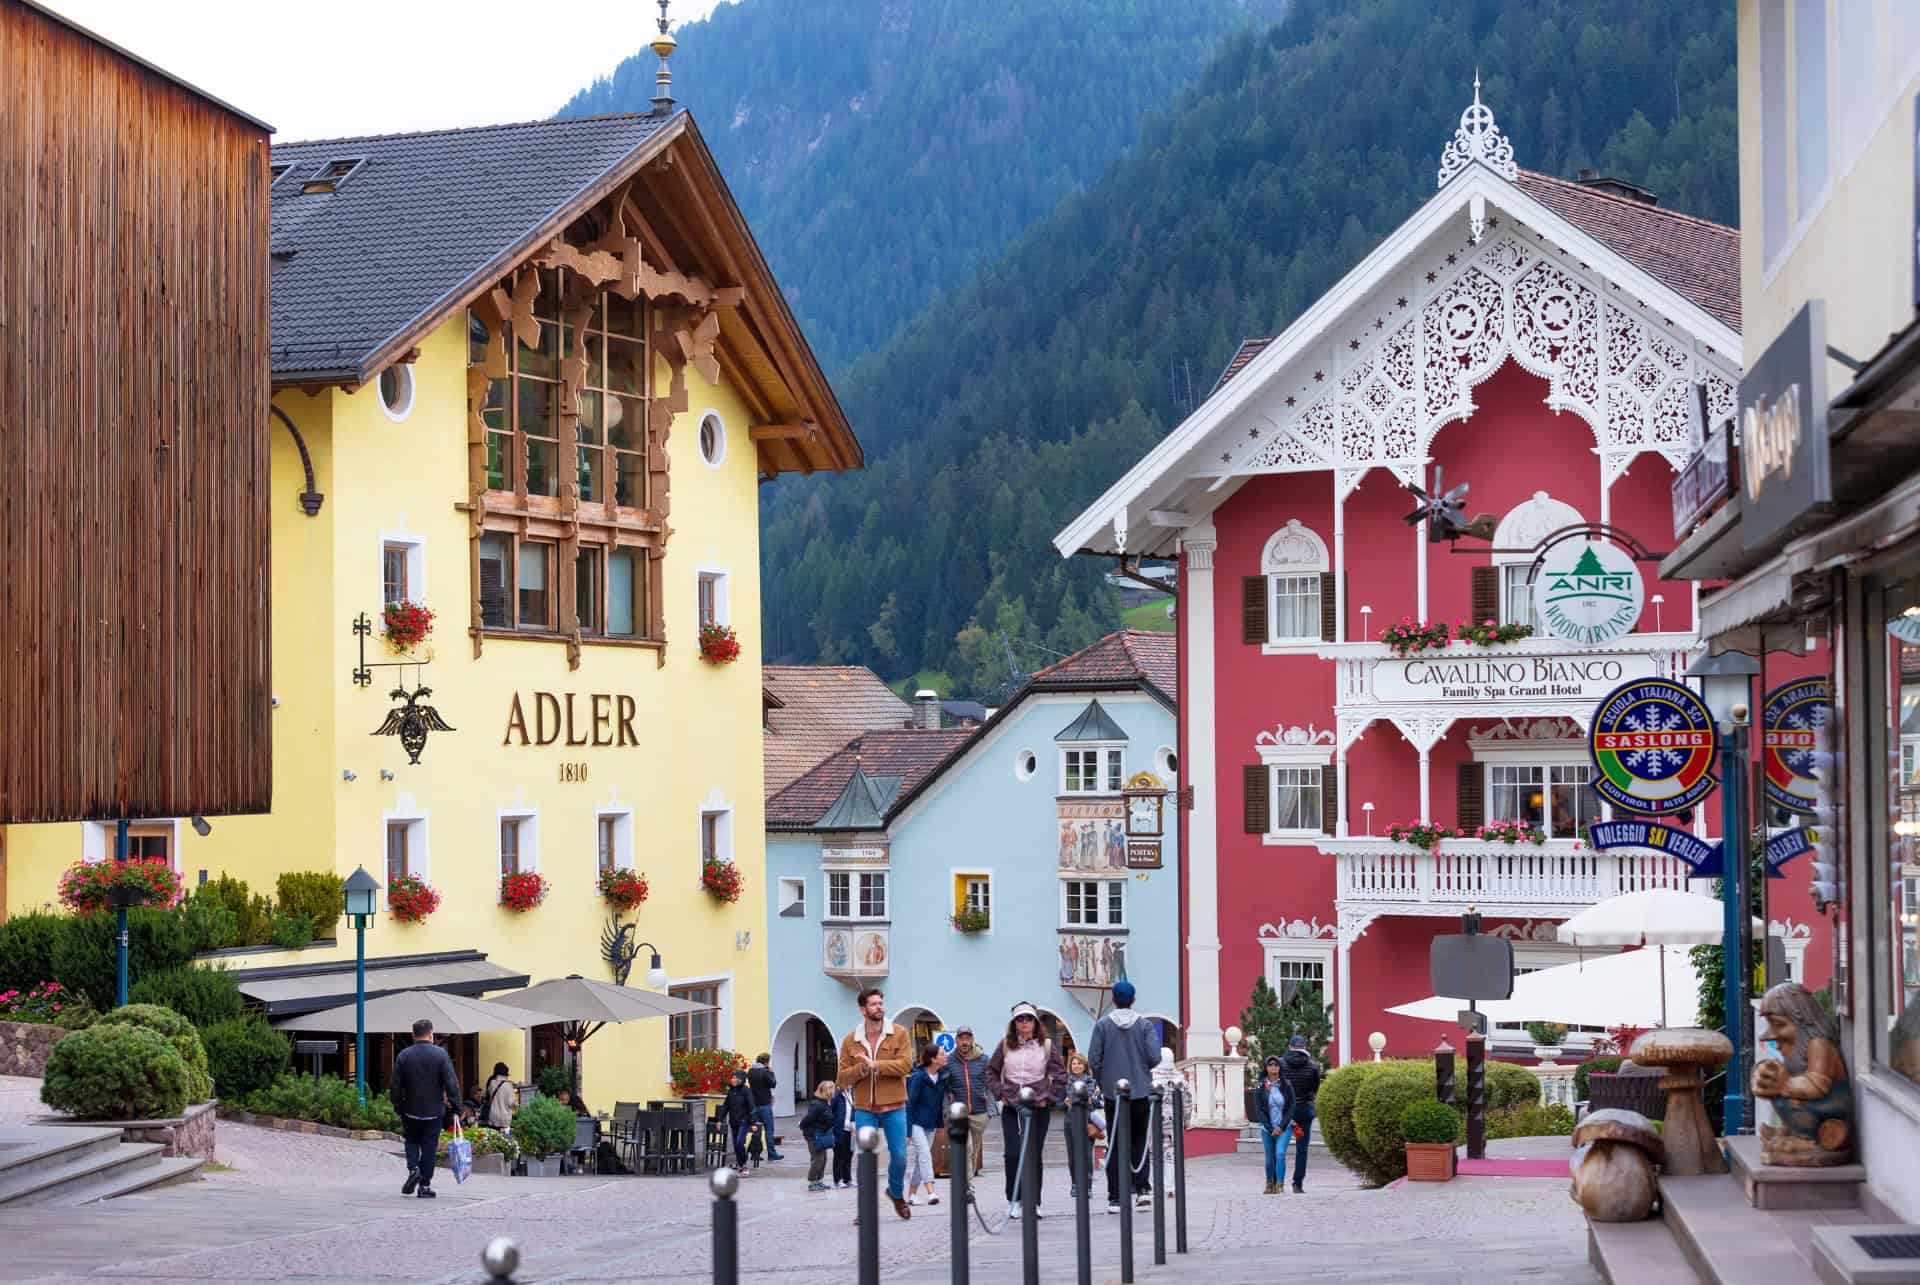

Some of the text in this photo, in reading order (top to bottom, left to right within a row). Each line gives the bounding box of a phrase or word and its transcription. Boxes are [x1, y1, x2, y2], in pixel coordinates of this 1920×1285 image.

[1549, 576, 1632, 591] ANRI
[1544, 604, 1637, 644] WOODCARVINGS
[1442, 684, 1582, 698] Family Spa Grand Hotel
[1603, 686, 1705, 725] SCUOLA ITALIANA SCI
[503, 688, 641, 747] ADLER
[1604, 733, 1703, 748] SASLONG
[559, 762, 588, 782] 1810
[1663, 796, 1686, 809] ALTO
[1596, 823, 1710, 865] NOLEGGIO SKI VERLEIH
